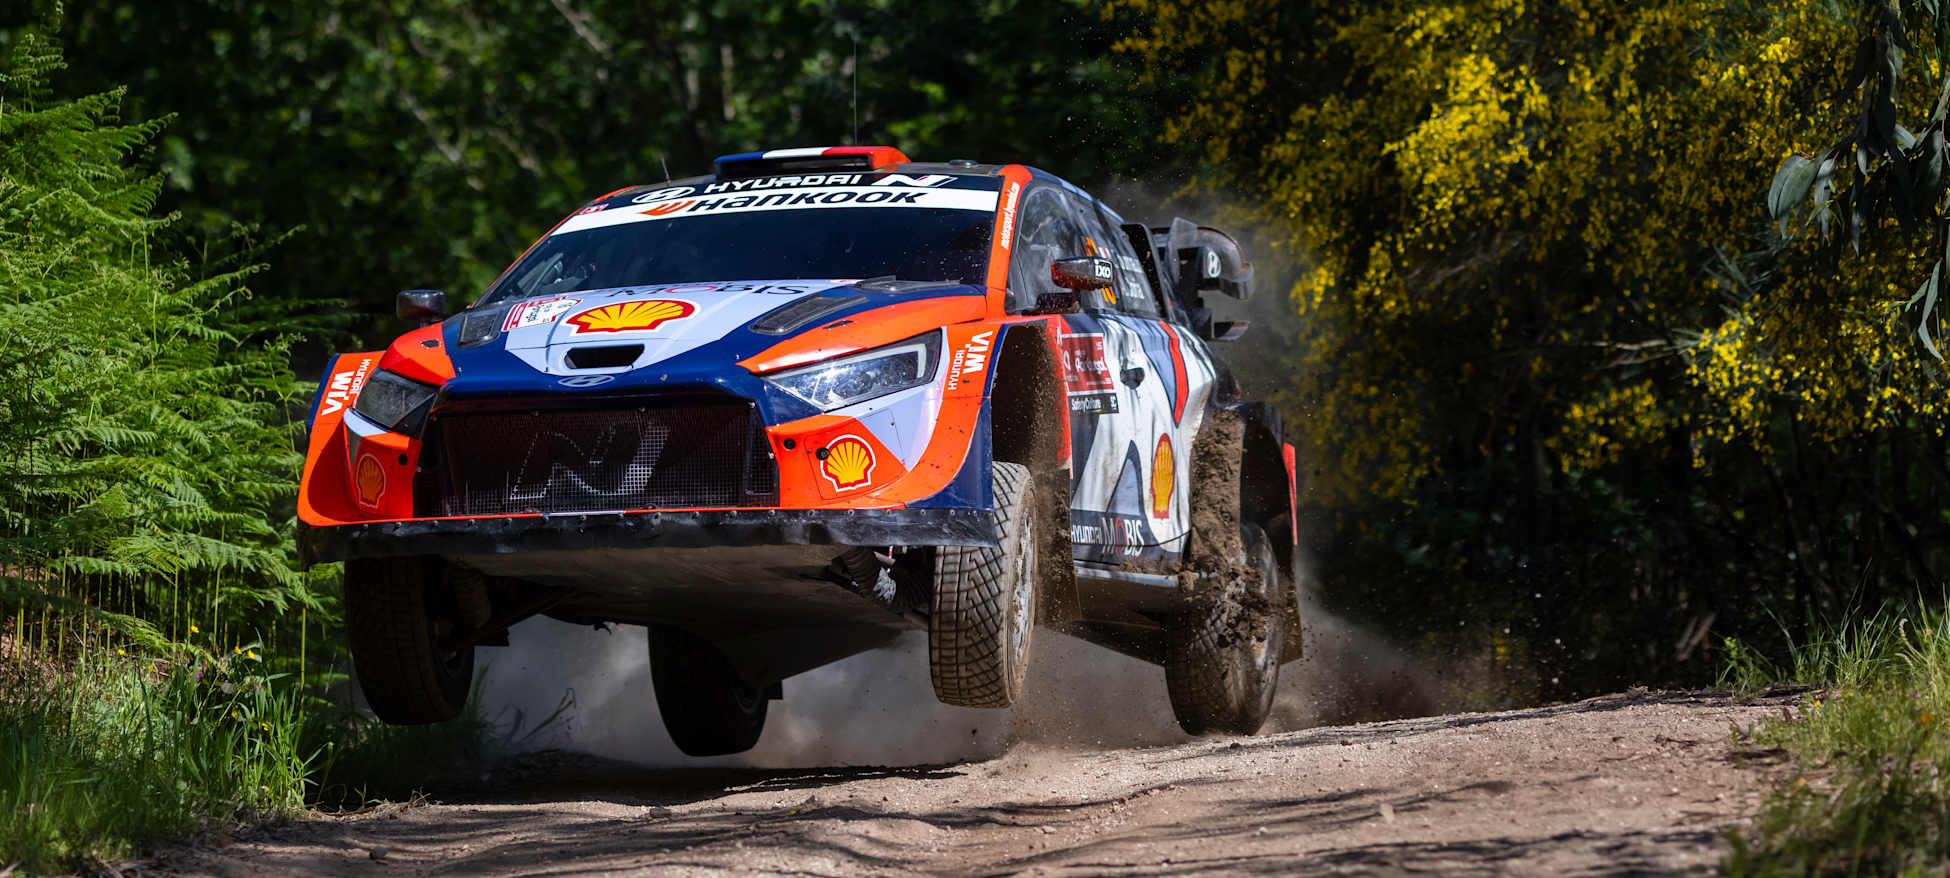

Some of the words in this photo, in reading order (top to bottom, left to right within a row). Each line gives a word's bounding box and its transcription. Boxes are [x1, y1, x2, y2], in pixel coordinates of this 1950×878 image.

[704, 174, 862, 193] HYUNDAI
[607, 285, 808, 297] MOBIS
[948, 350, 965, 390] HYUNDAI
[1071, 525, 1103, 545] HYUNDAI
[1102, 517, 1145, 557] MOBIS
